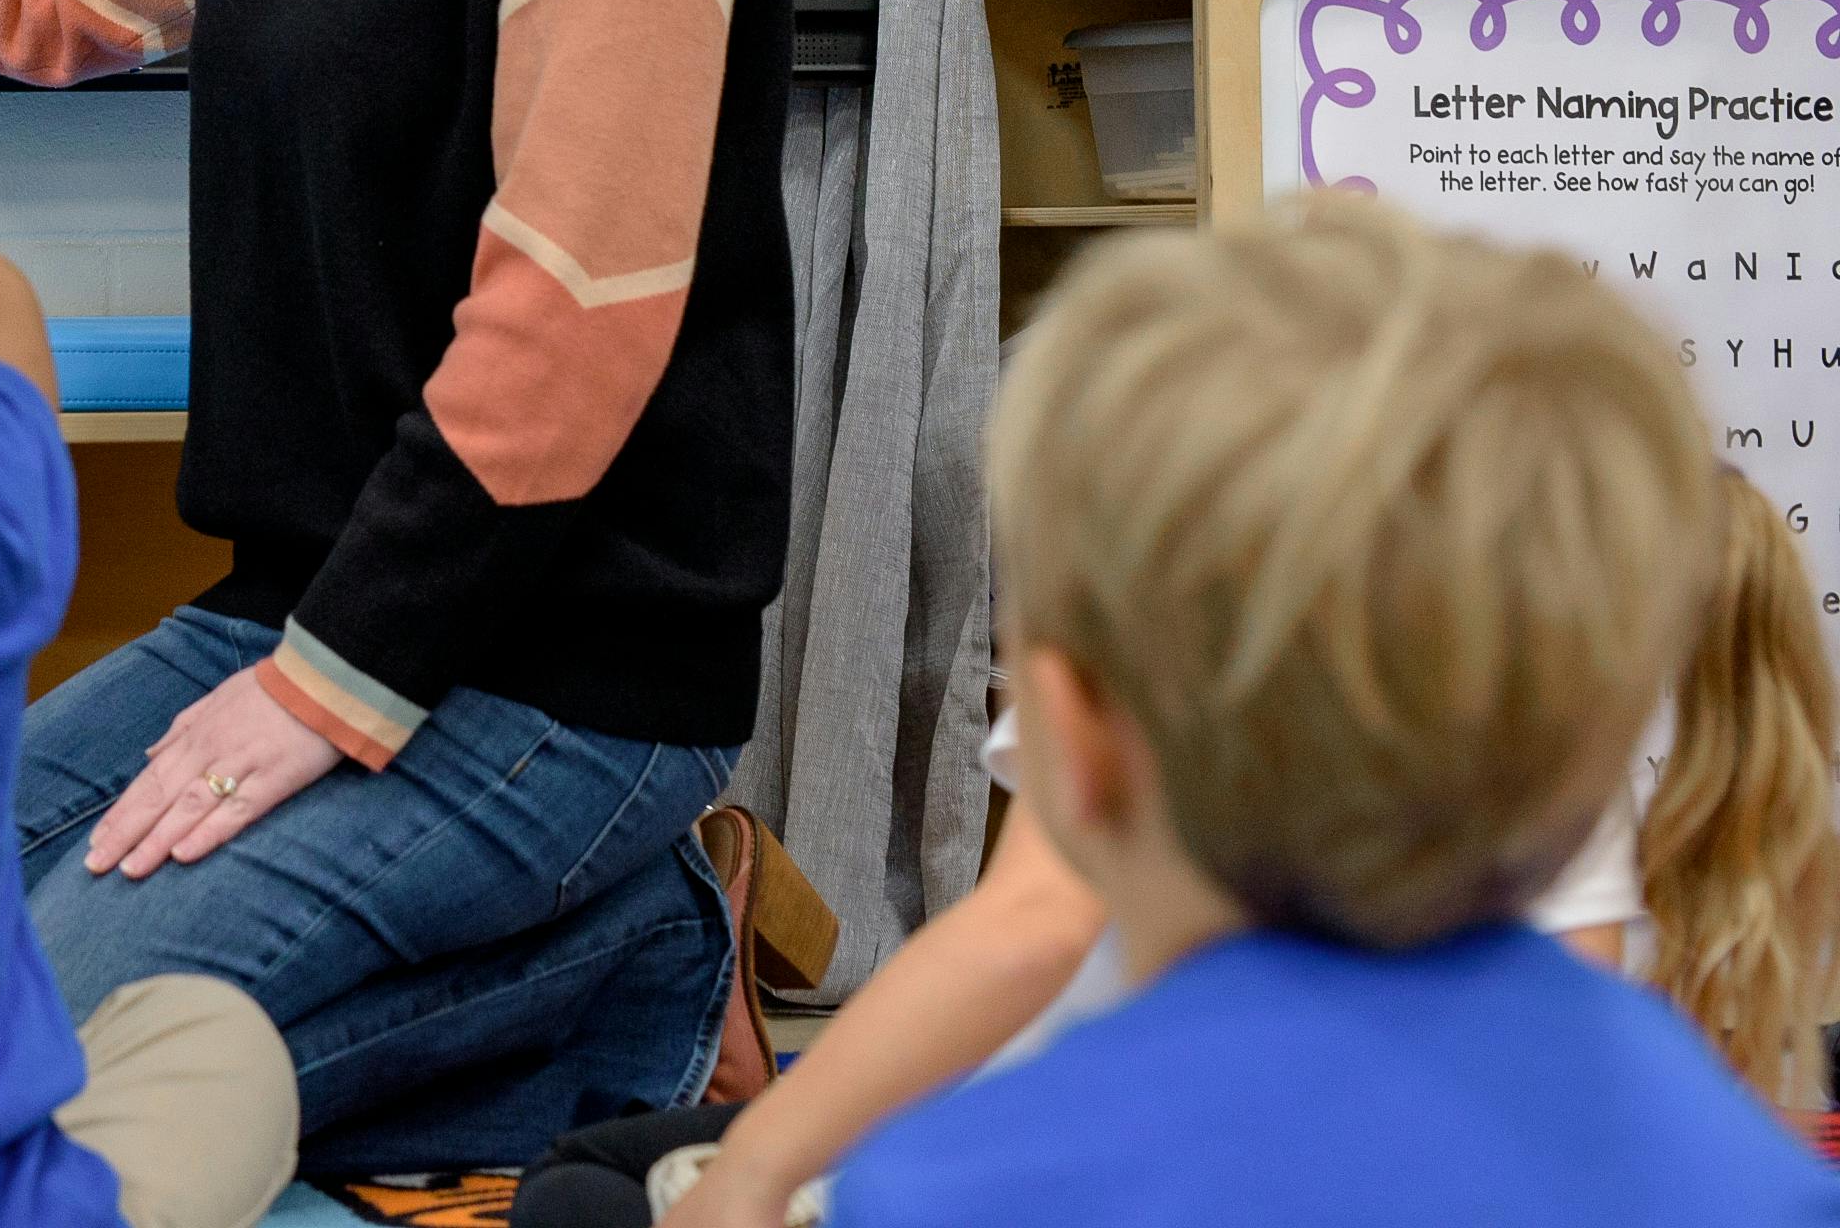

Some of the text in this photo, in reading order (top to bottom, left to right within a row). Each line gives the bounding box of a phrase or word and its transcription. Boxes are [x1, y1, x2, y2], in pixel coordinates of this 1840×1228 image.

[1414, 84, 1834, 140] Letter Naming Practice
[1409, 143, 1840, 175] Point to each letter and say the name of
[1439, 170, 1815, 205] the letter. See how fast you can go!
[1628, 250, 1658, 279] W
[1687, 259, 1707, 281] a
[1735, 251, 1757, 281] N
[1726, 339, 1744, 368] Y
[1773, 338, 1792, 369] H
[1726, 419, 1815, 449] m U
[1786, 502, 1809, 535] G
